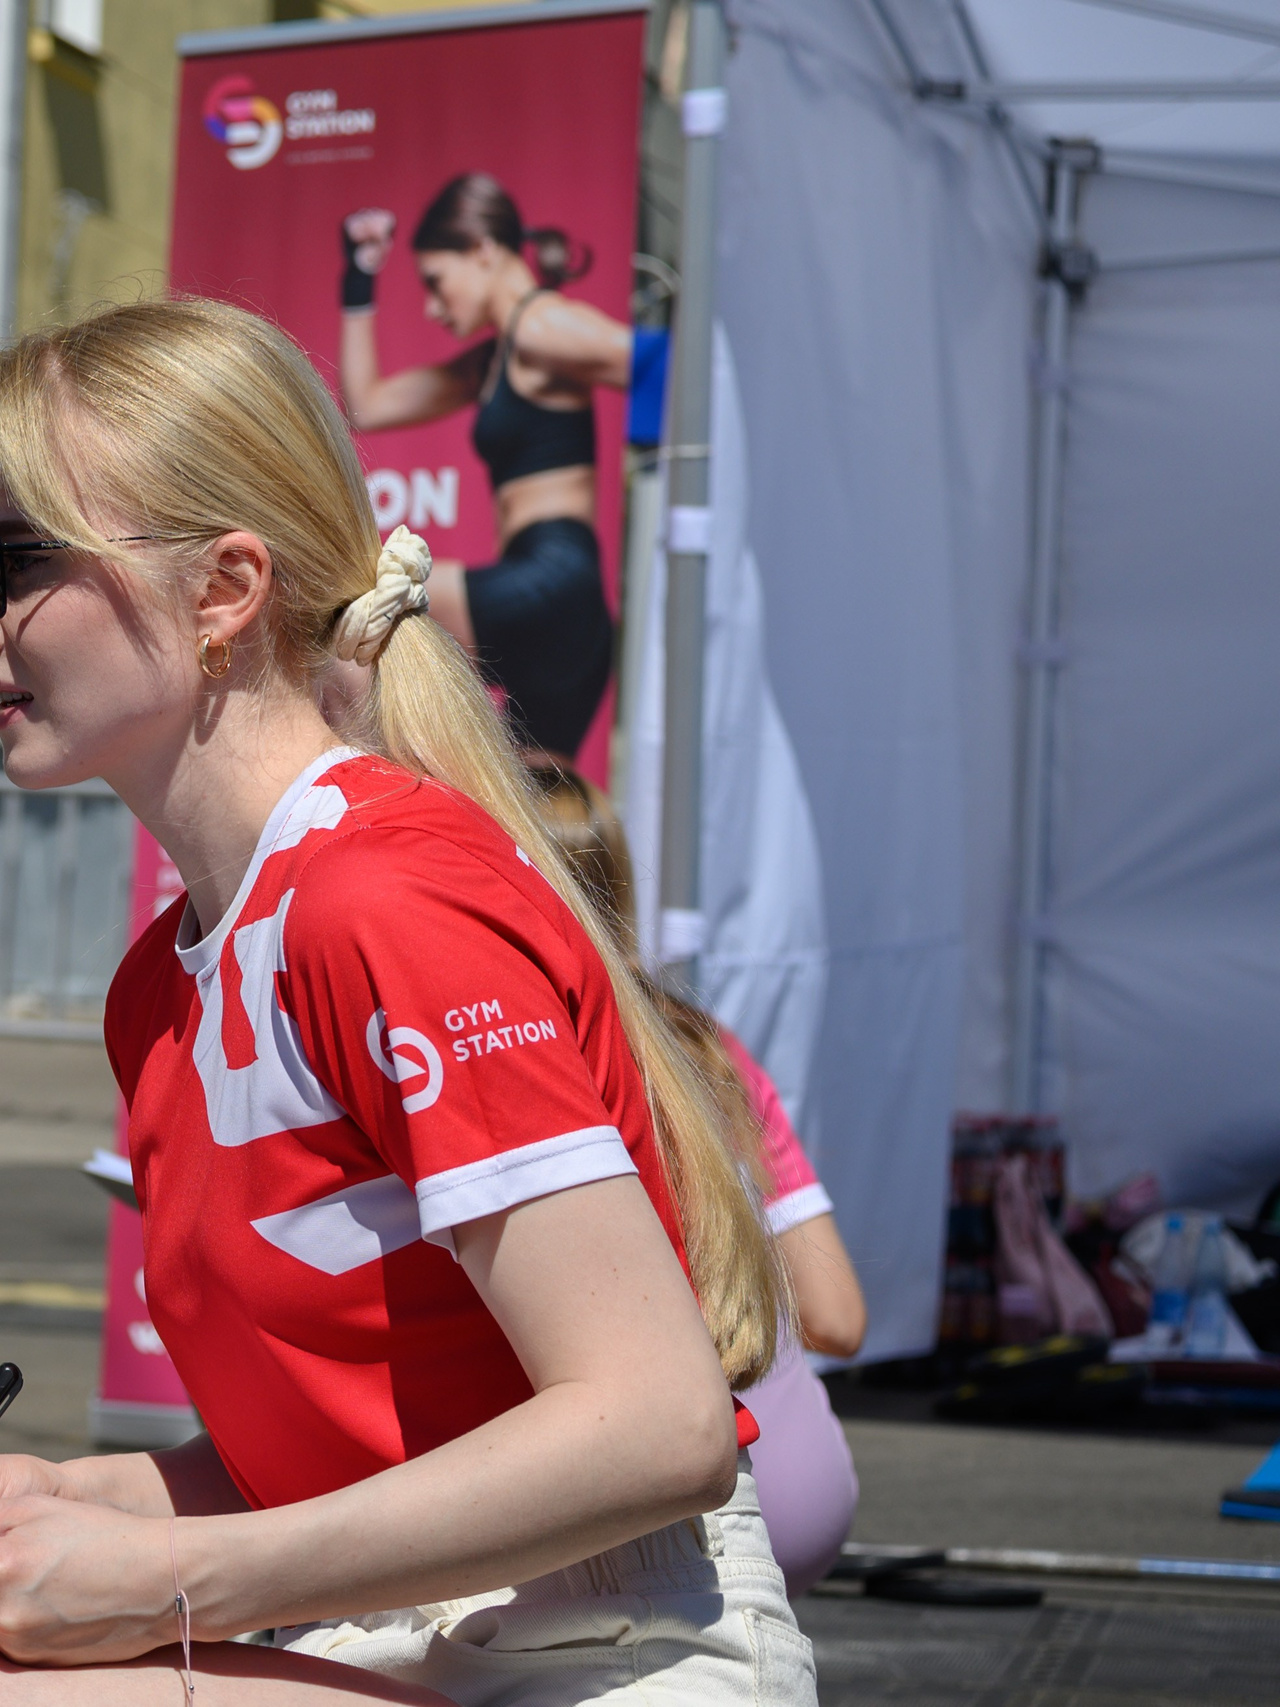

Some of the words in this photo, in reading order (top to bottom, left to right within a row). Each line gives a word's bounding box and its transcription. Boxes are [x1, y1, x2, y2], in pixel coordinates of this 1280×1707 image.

[286, 108, 376, 139] STATION
[444, 999, 504, 1032] GYM
[452, 1019, 557, 1062] STATION
